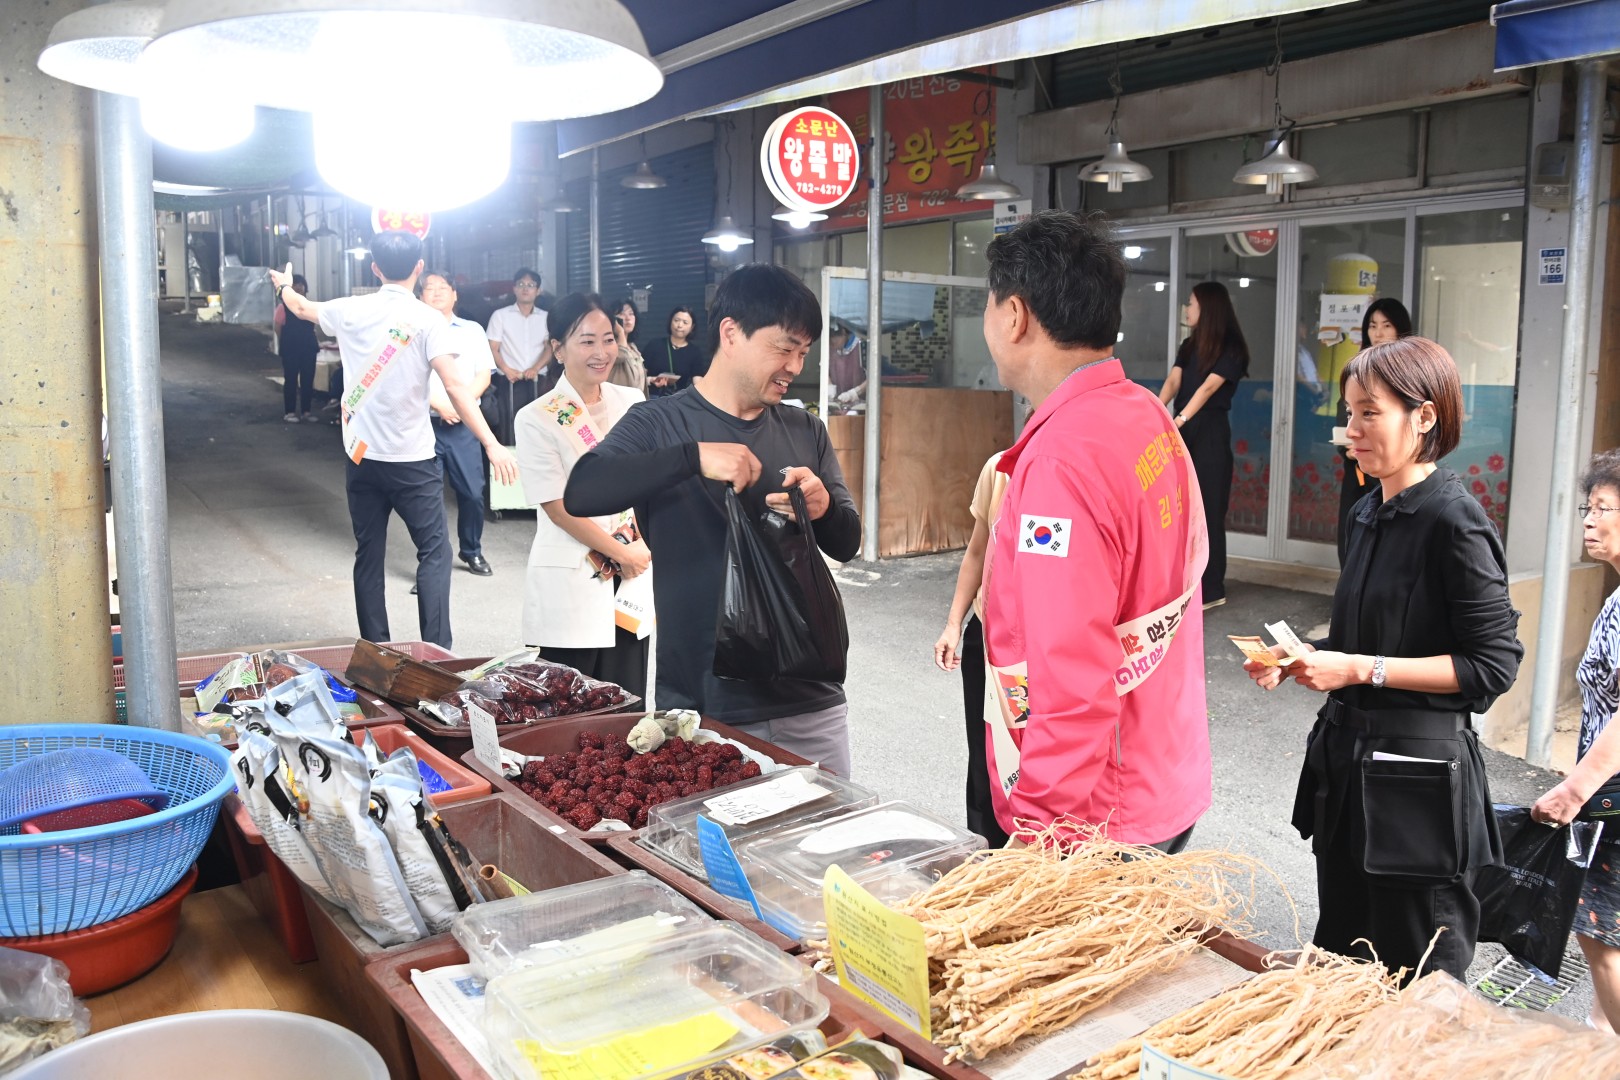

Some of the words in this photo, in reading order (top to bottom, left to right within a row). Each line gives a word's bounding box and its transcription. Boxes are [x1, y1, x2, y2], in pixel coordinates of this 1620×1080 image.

[795, 118, 838, 137] 소문난
[1544, 263, 1562, 274] 166
[1112, 644, 1164, 687] 장보G
